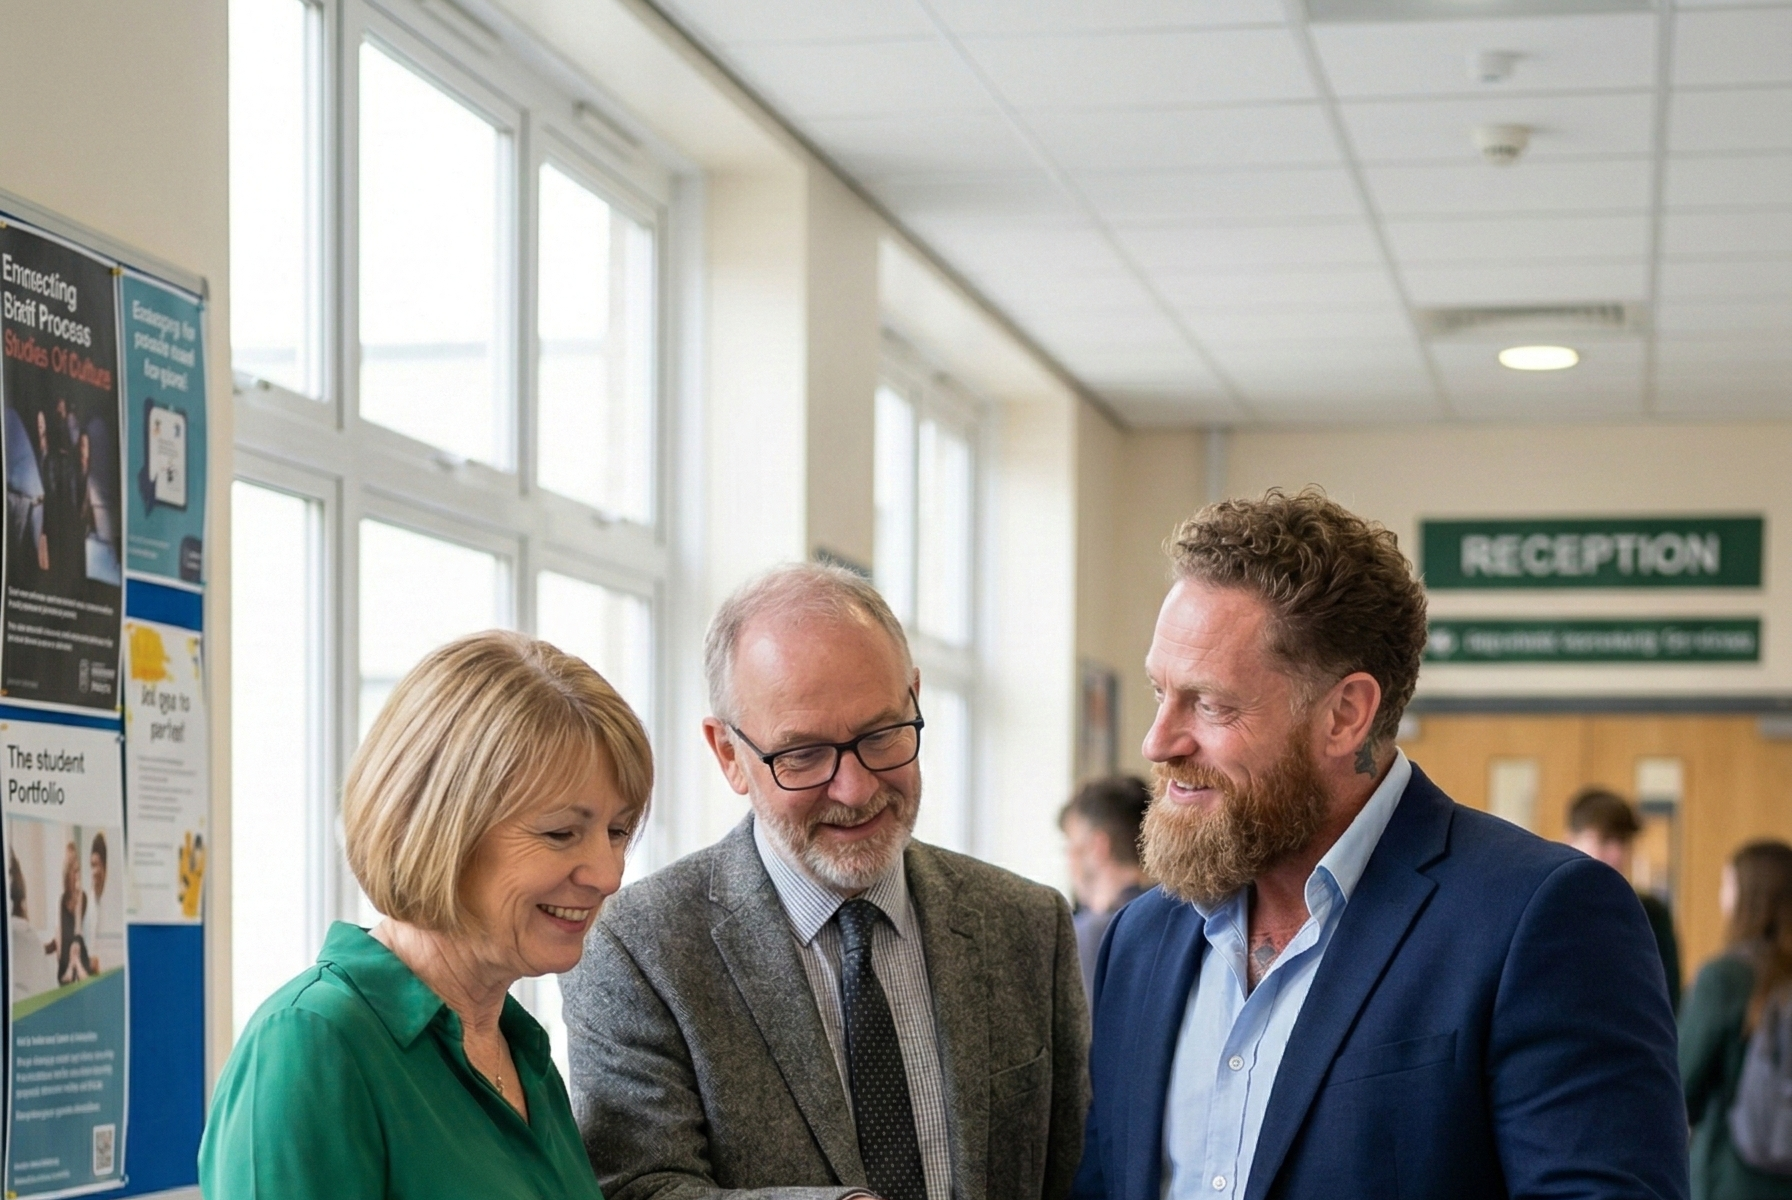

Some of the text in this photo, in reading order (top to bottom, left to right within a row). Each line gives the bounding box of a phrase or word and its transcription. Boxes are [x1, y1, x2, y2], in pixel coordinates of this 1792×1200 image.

[1459, 531, 1721, 577] RECEPTION
[6, 744, 85, 774] The student
[8, 778, 65, 805] Portfolio
